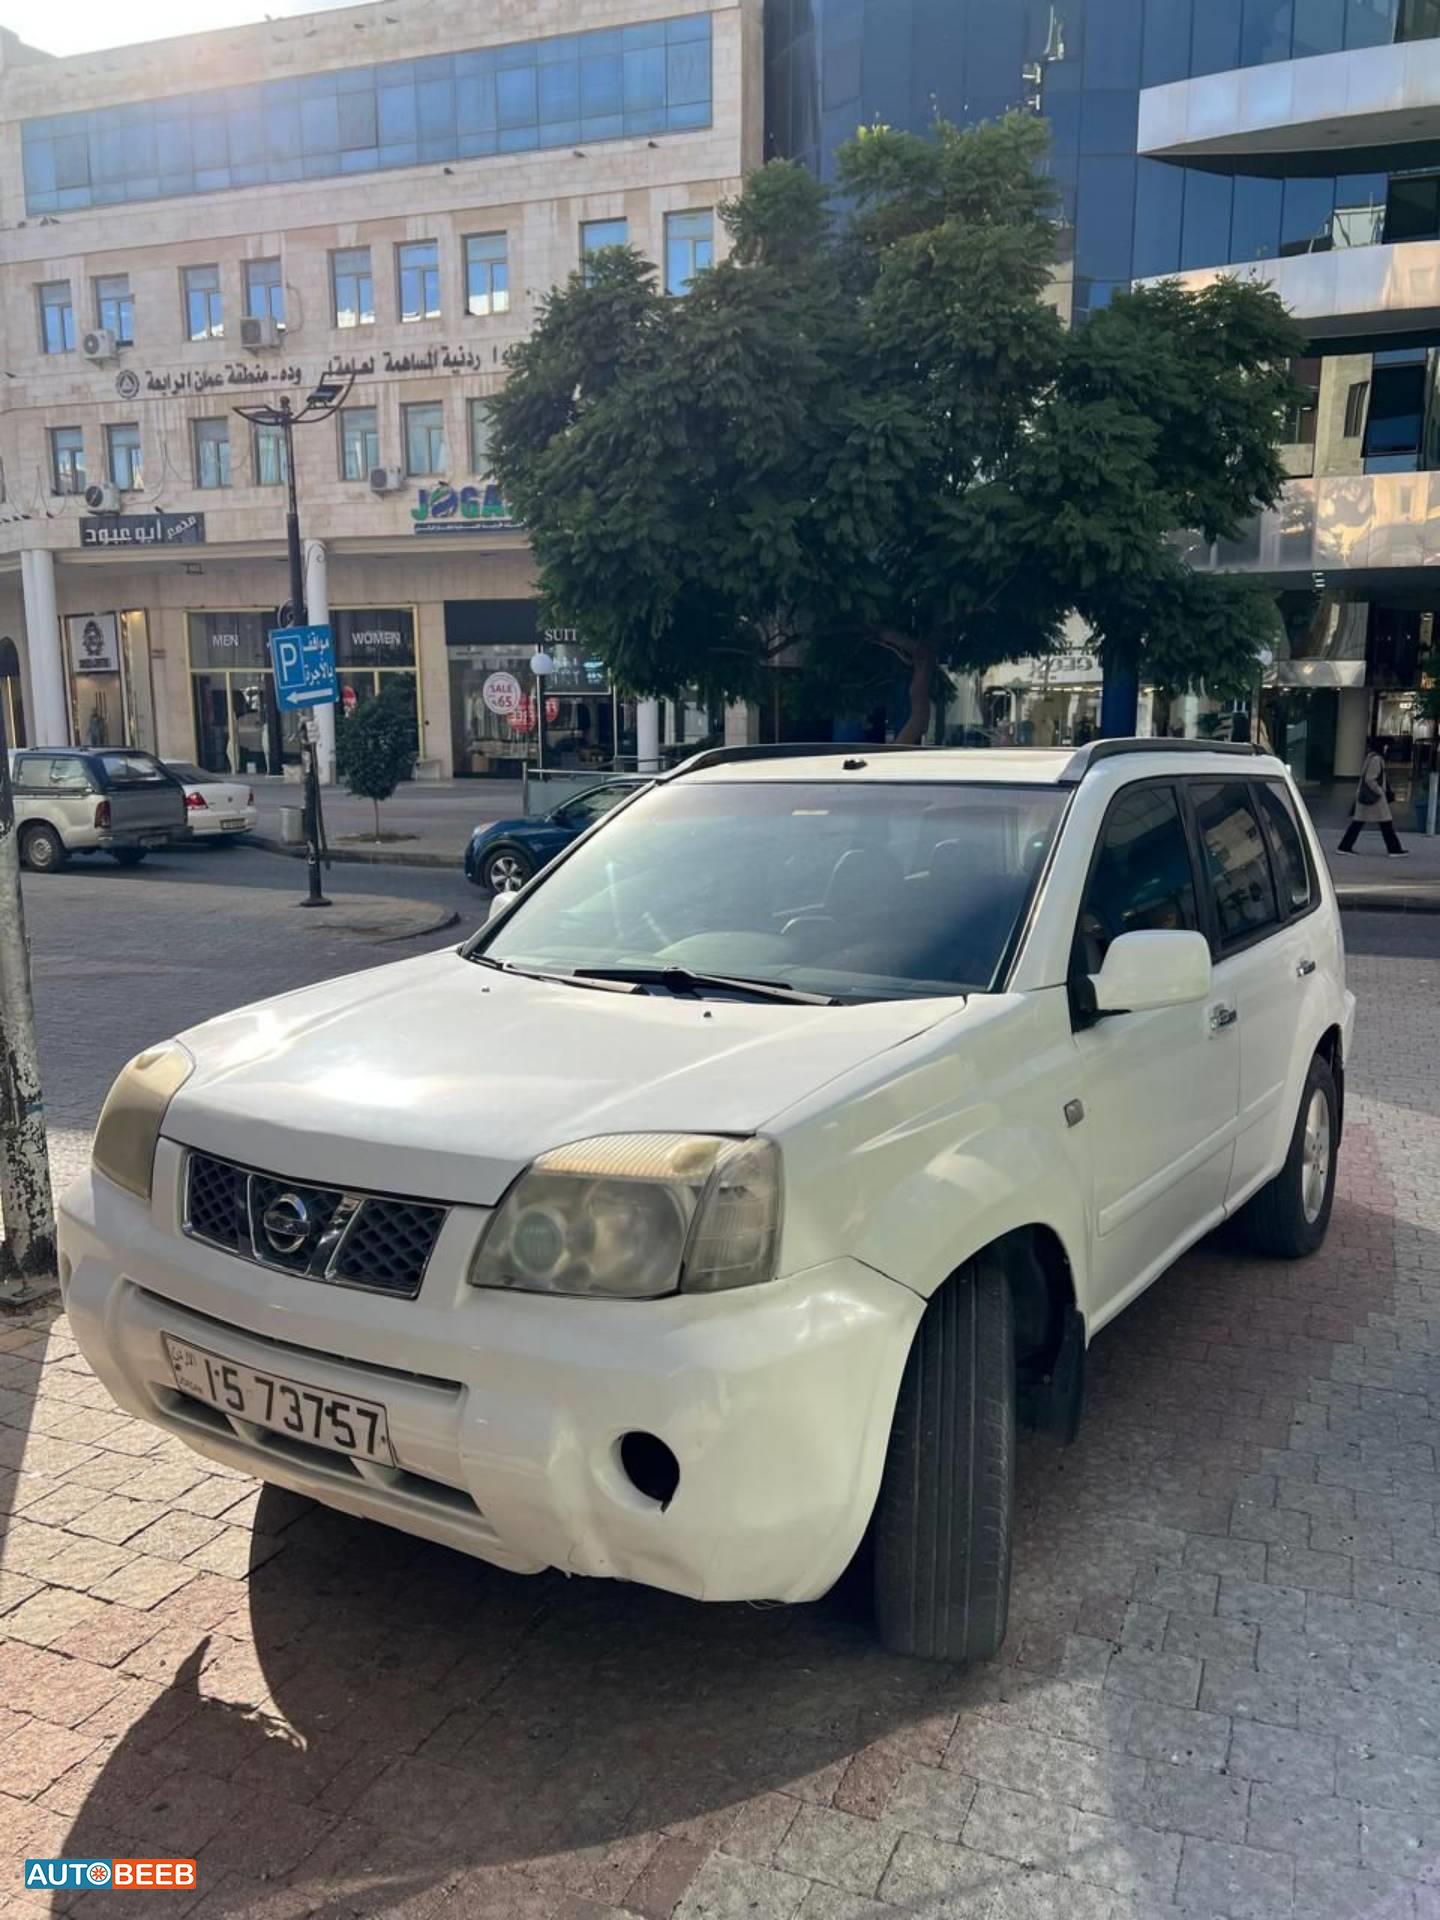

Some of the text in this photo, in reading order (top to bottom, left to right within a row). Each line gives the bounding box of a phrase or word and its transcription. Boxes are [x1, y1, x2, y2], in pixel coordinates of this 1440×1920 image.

[411, 484, 514, 521] JOGA
[212, 634, 239, 647] MEN
[351, 630, 401, 645] WOMEN
[279, 642, 298, 682] P
[489, 684, 513, 693] SALE
[254, 1375, 379, 1455] 73757
